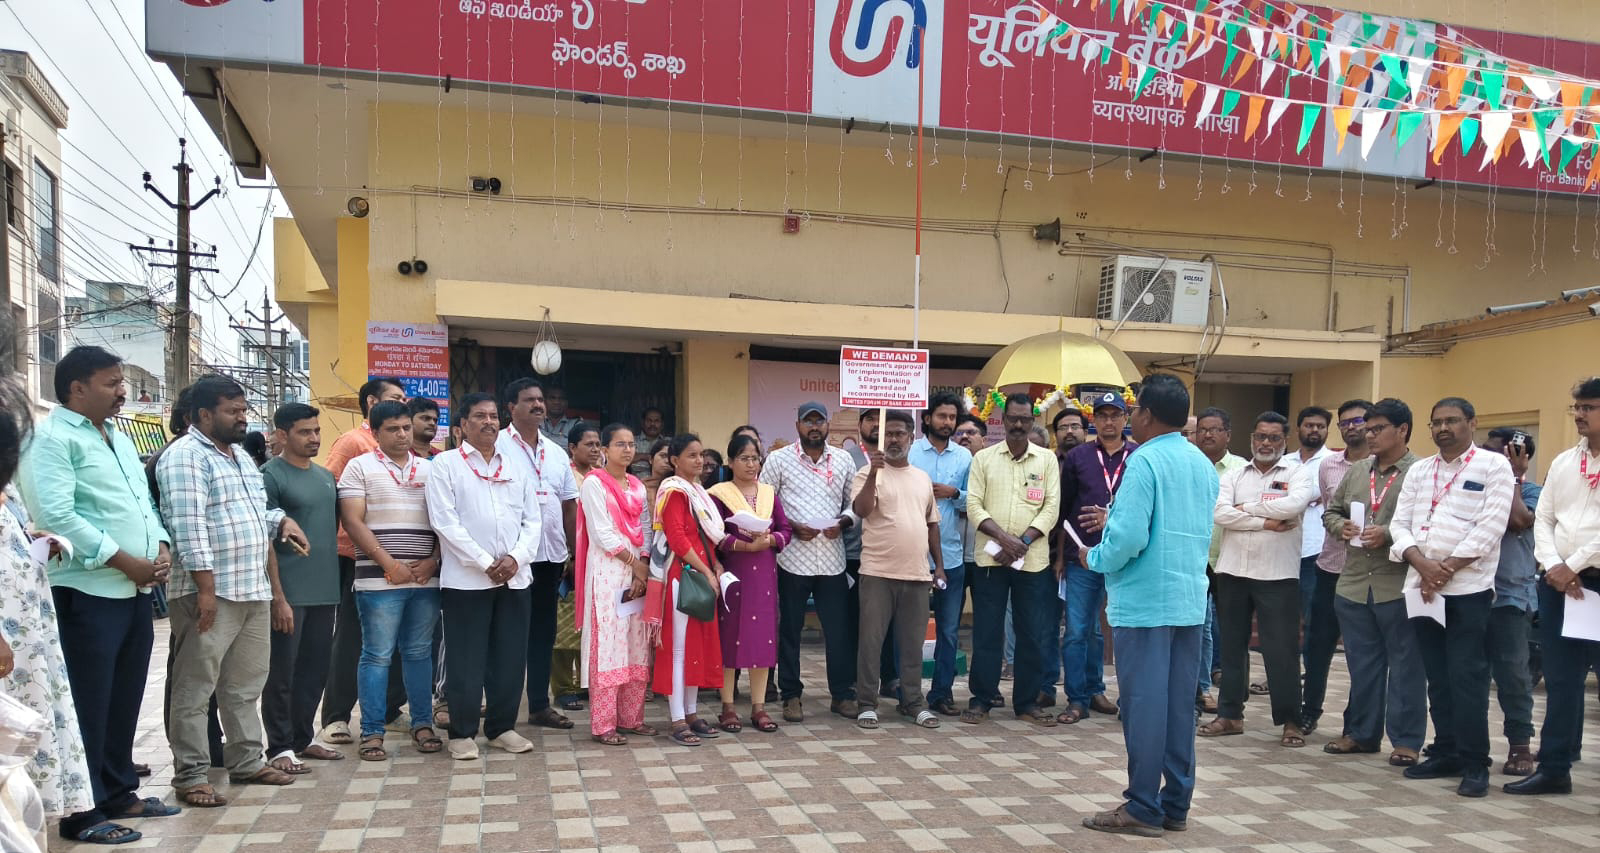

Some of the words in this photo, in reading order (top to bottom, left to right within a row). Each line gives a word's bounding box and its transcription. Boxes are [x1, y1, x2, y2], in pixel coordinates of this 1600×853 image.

[1093, 100, 1186, 128] व्यवस्थापक
[1540, 171, 1556, 183] For
[1559, 173, 1597, 191] Bankig
[852, 350, 869, 360] WE
[871, 351, 918, 361] DEMAND
[845, 360, 893, 369] Government's
[894, 363, 924, 371] approval
[859, 368, 912, 377] implementation
[863, 376, 881, 384] Days
[882, 377, 911, 385] Banking
[418, 379, 439, 396] 4-00
[869, 384, 893, 392] agreed
[847, 391, 896, 399] recommended
[897, 392, 906, 400] by
